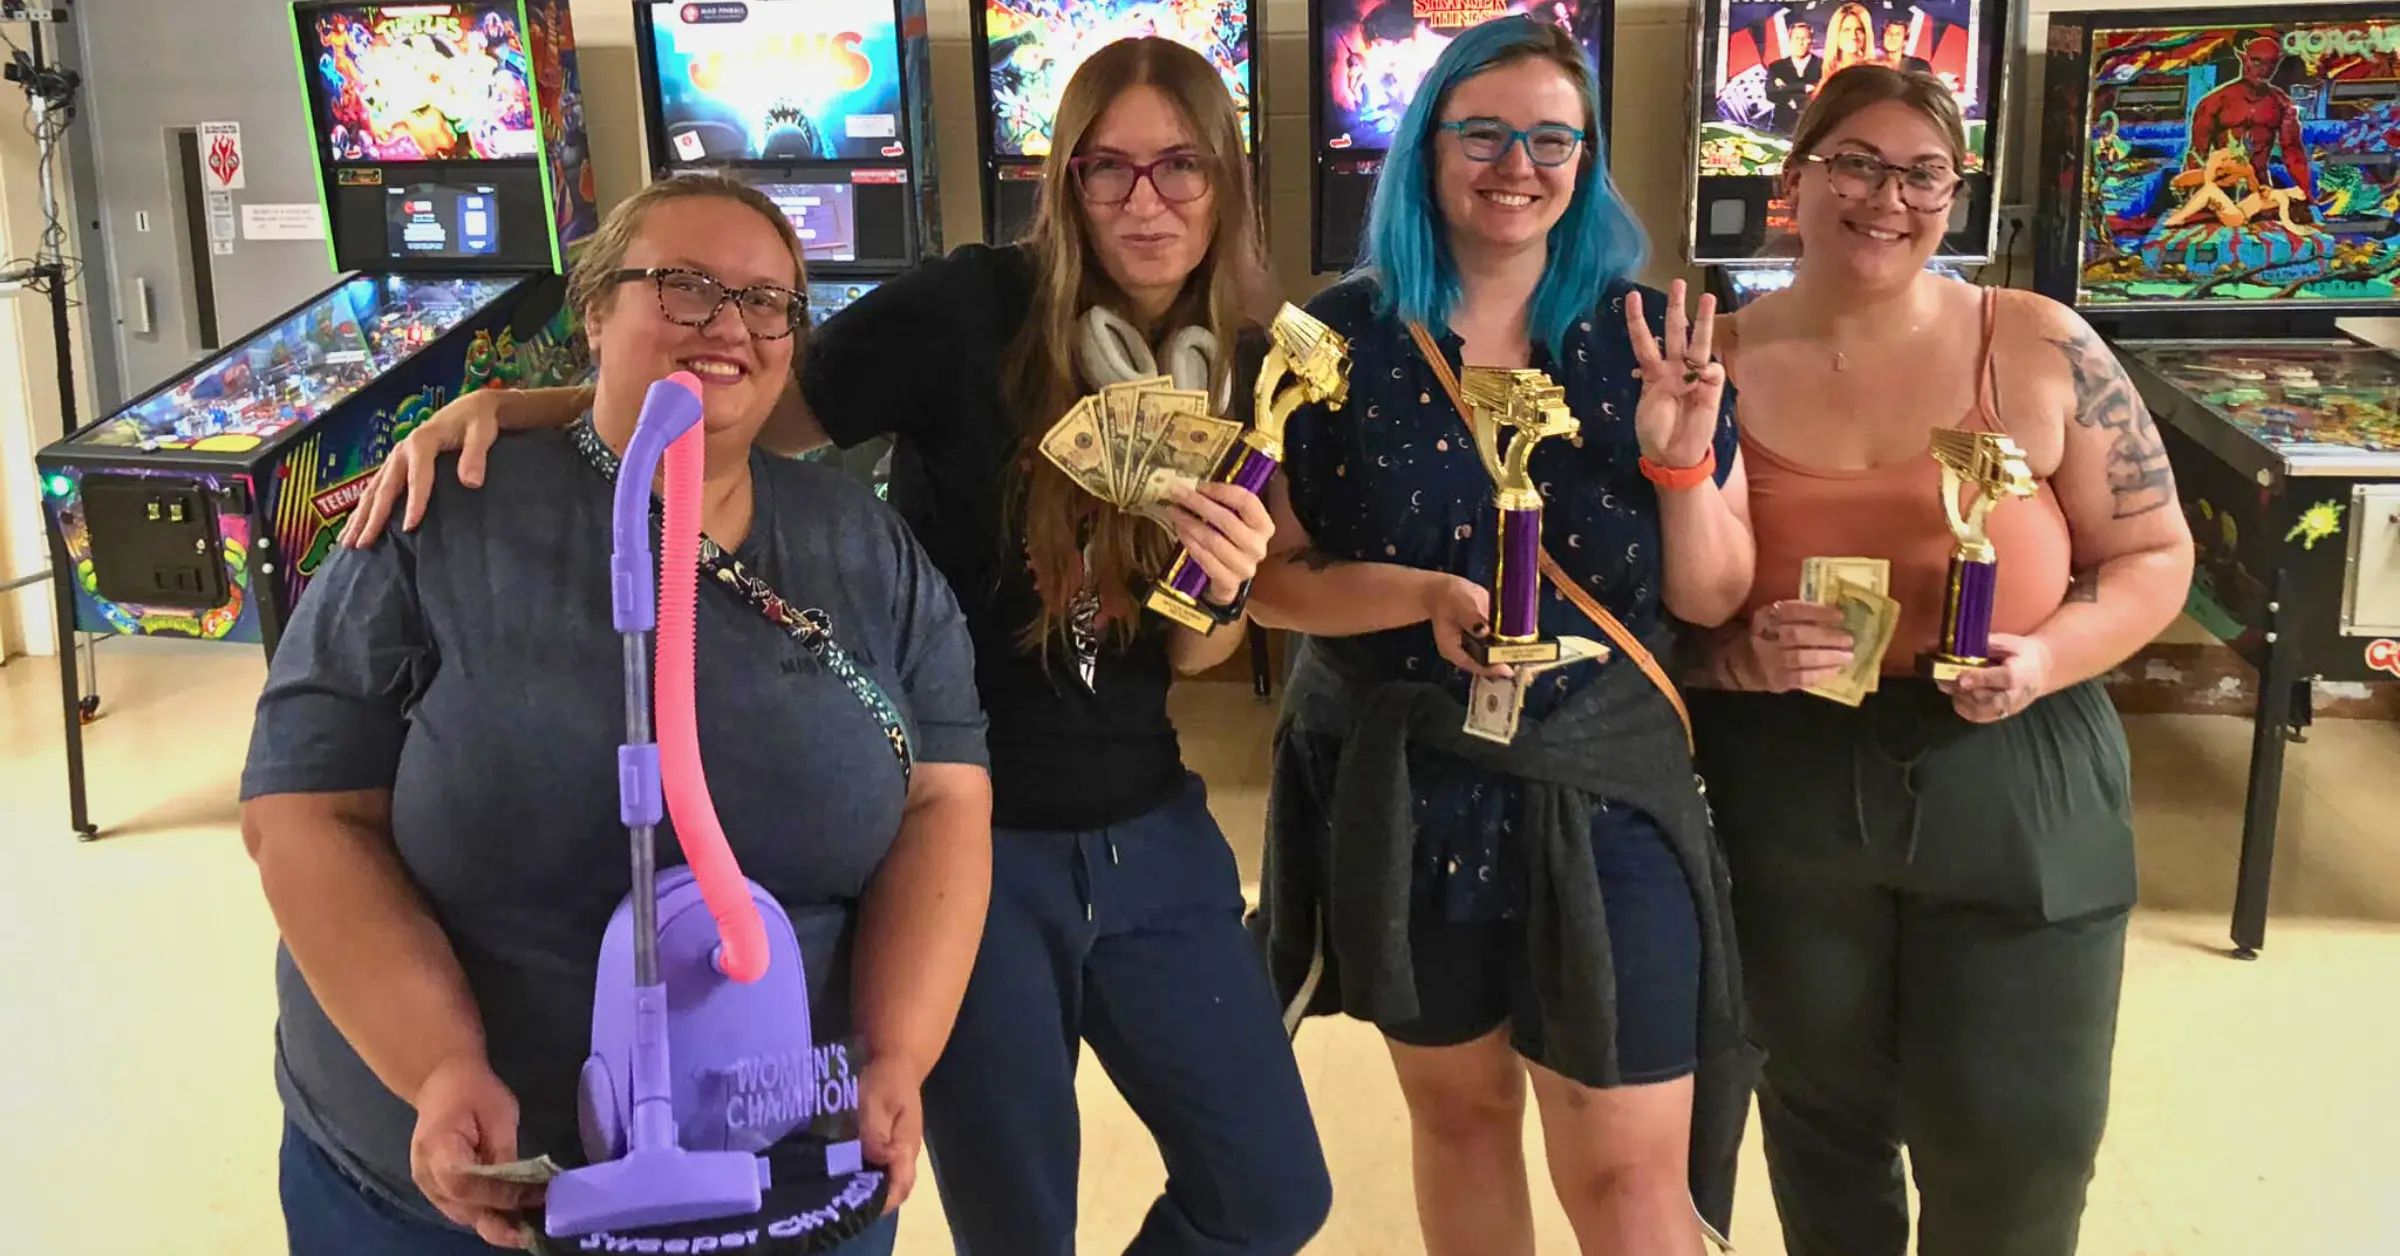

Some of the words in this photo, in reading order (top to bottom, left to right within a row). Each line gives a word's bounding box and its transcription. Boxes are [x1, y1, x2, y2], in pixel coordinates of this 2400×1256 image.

[374, 15, 464, 45] TURTLES
[1430, 11, 1493, 27] THINGS
[690, 31, 871, 91] JWS
[737, 1042, 849, 1093] WOMEN'S
[726, 1074, 859, 1128] CHAMPION
